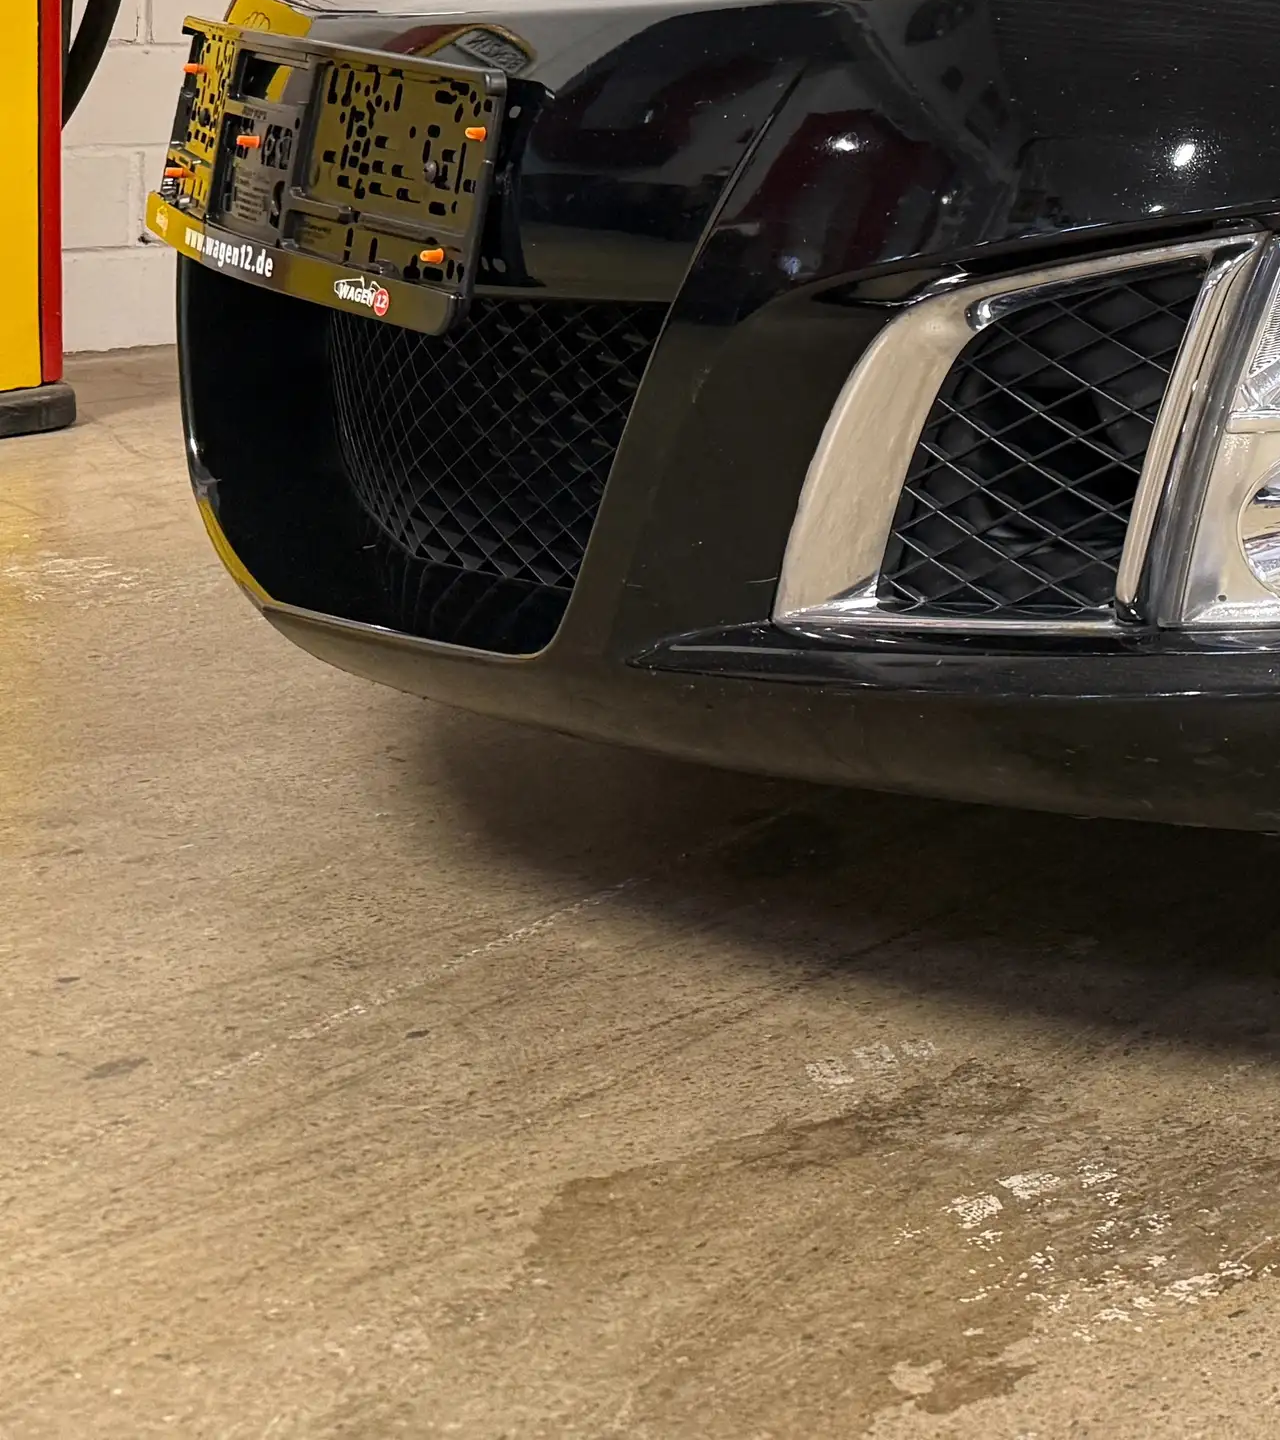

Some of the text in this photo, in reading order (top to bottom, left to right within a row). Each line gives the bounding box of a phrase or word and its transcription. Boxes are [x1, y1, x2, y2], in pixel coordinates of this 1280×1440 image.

[184, 226, 274, 278] www.wagen12.de
[338, 281, 388, 309] WAGEN 12
